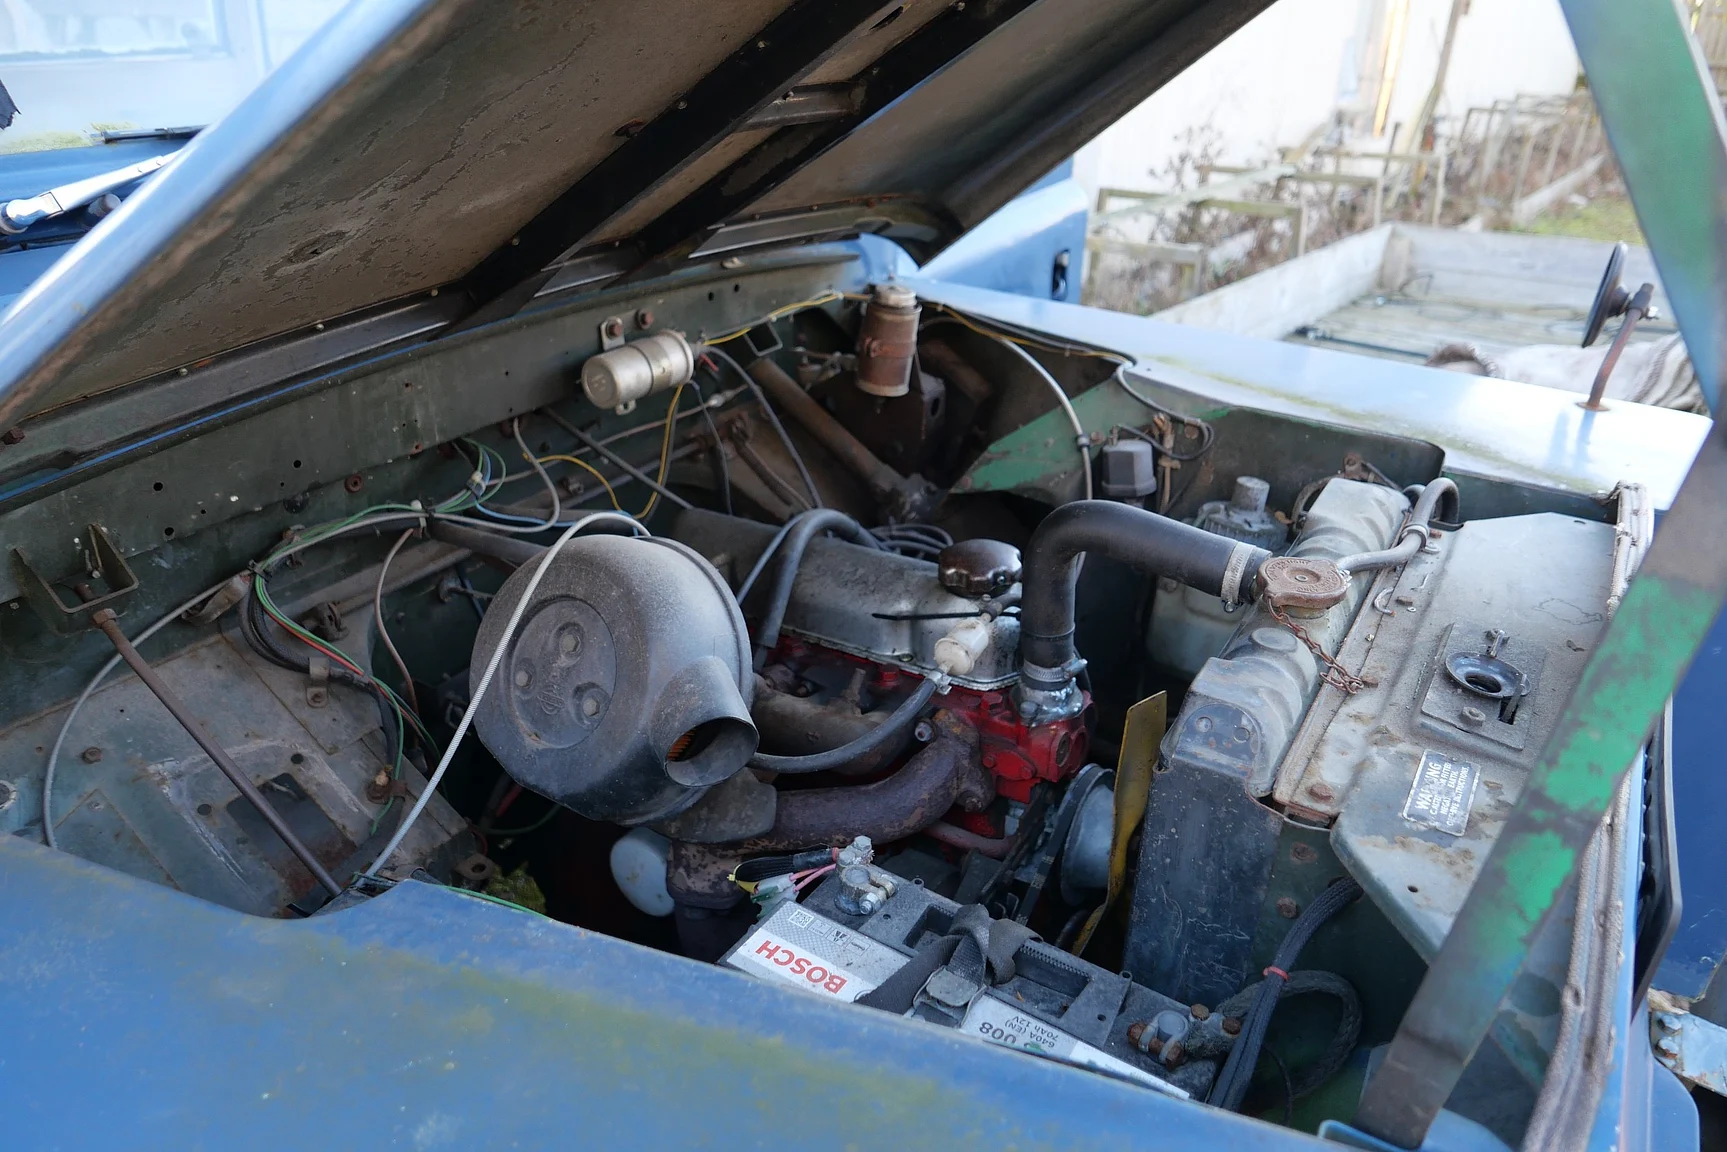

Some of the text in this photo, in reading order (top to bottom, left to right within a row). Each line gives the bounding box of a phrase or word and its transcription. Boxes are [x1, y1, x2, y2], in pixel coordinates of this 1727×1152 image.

[755, 940, 848, 994] BOSCH
[1004, 1019, 1055, 1048] 640A (EN)
[1012, 1016, 1059, 1041] 70Ah 12V
